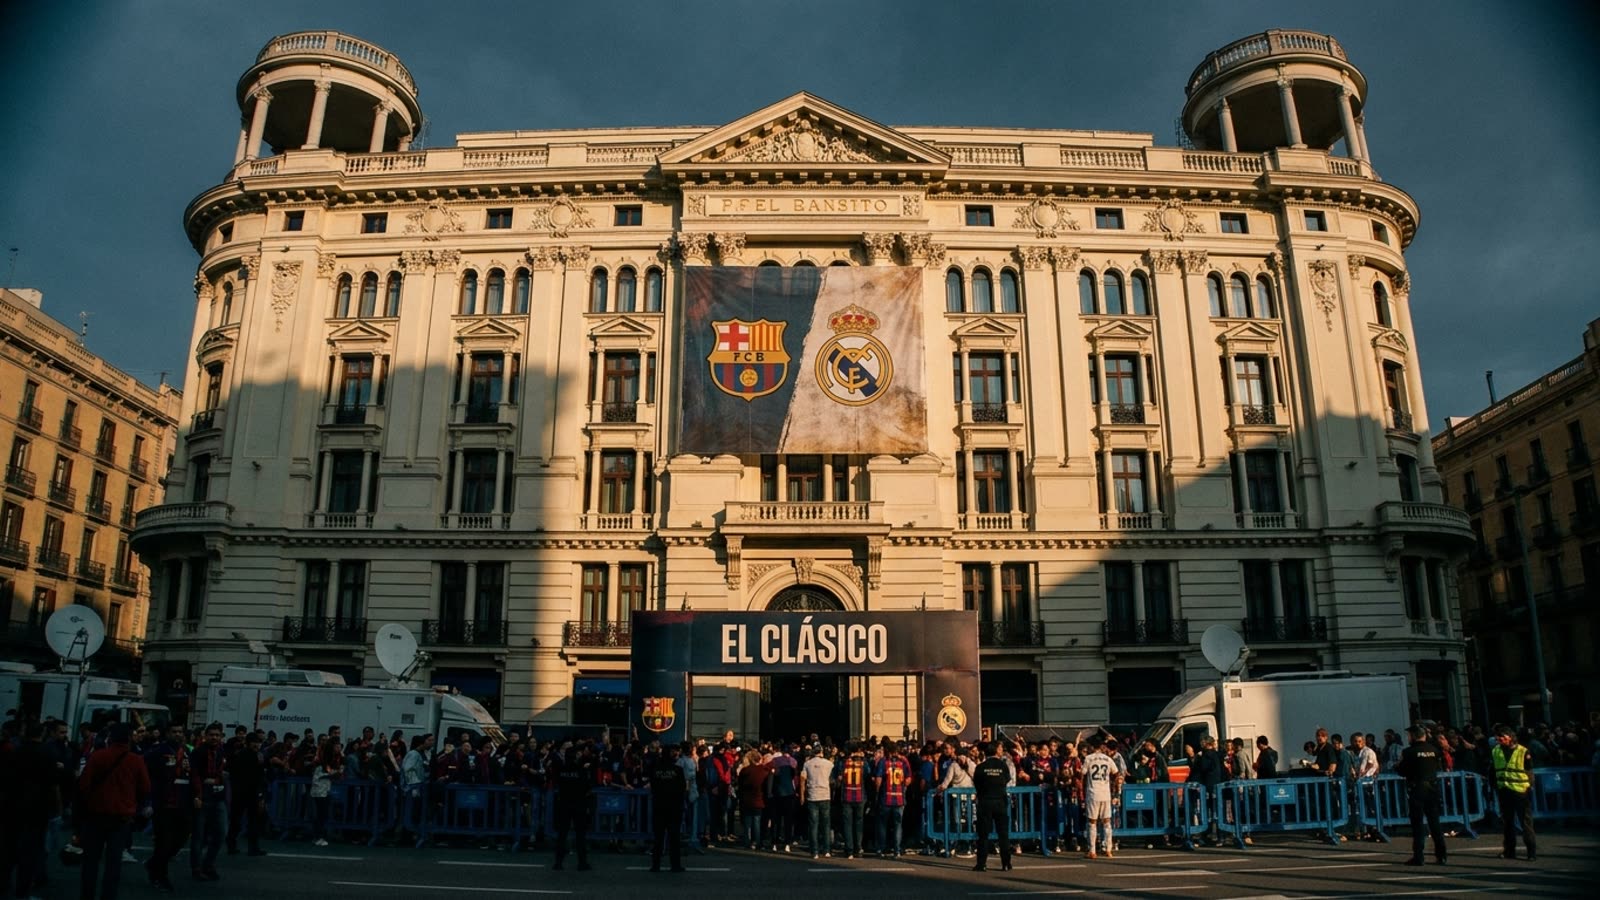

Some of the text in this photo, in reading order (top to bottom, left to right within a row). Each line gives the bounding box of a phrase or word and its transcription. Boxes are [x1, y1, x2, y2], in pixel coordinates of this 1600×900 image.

[721, 615, 888, 664] EL CLÁSICO
[844, 767, 861, 785] 11
